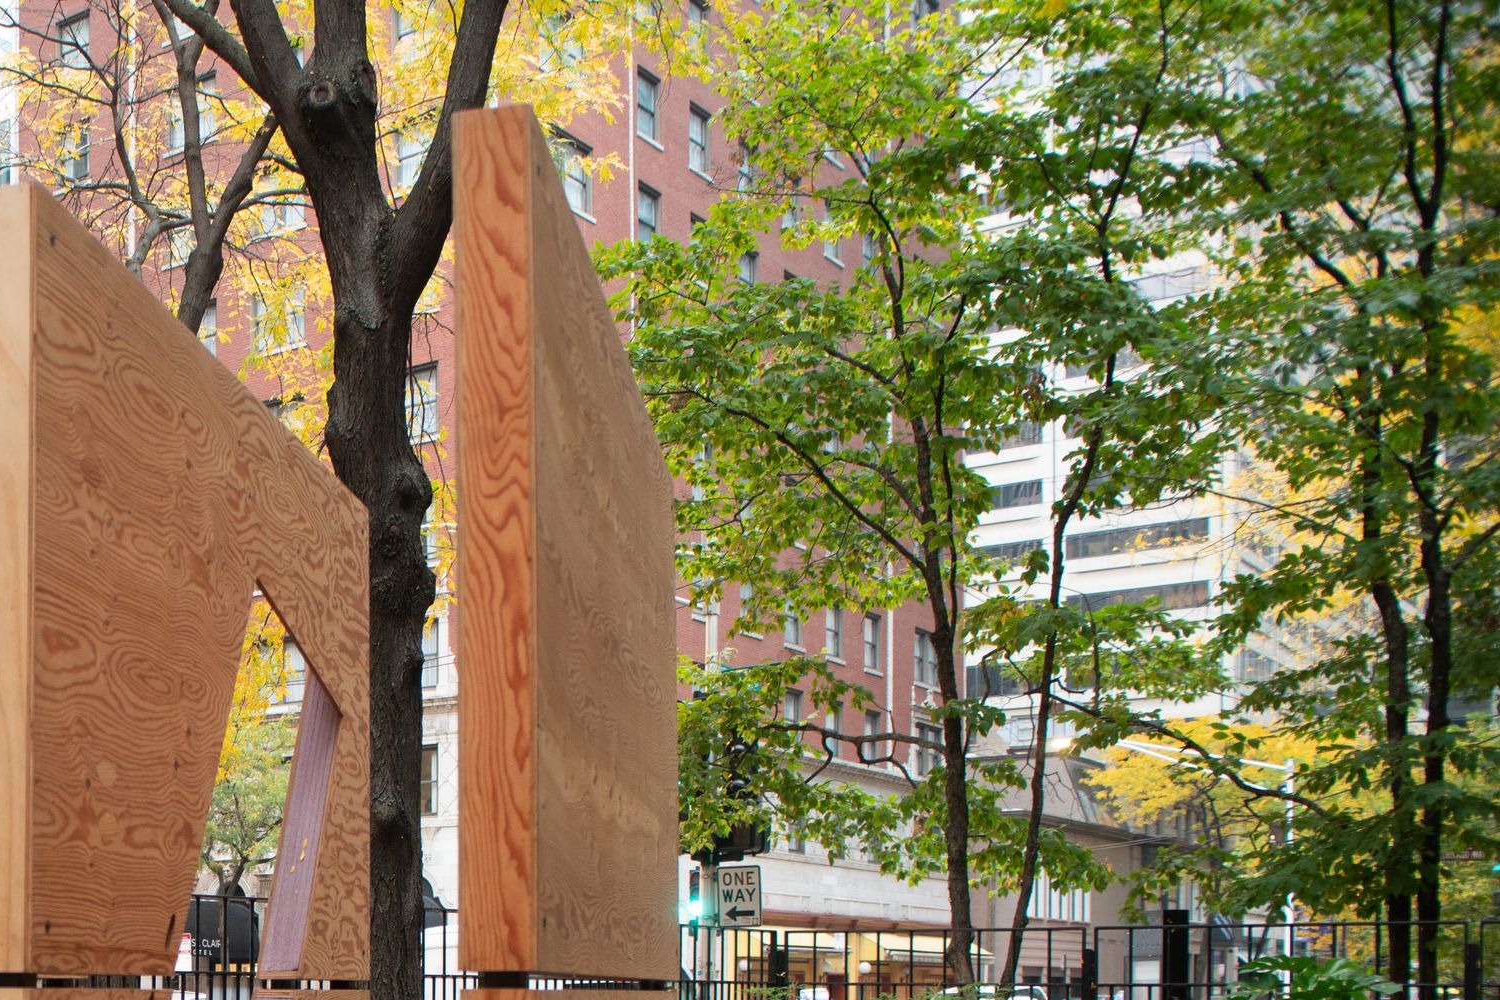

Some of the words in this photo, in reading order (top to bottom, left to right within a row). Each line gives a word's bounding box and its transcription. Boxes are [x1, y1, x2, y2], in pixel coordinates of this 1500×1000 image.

[722, 871, 755, 886] ONE
[722, 888, 756, 903] WAY
[191, 938, 202, 948] S.
